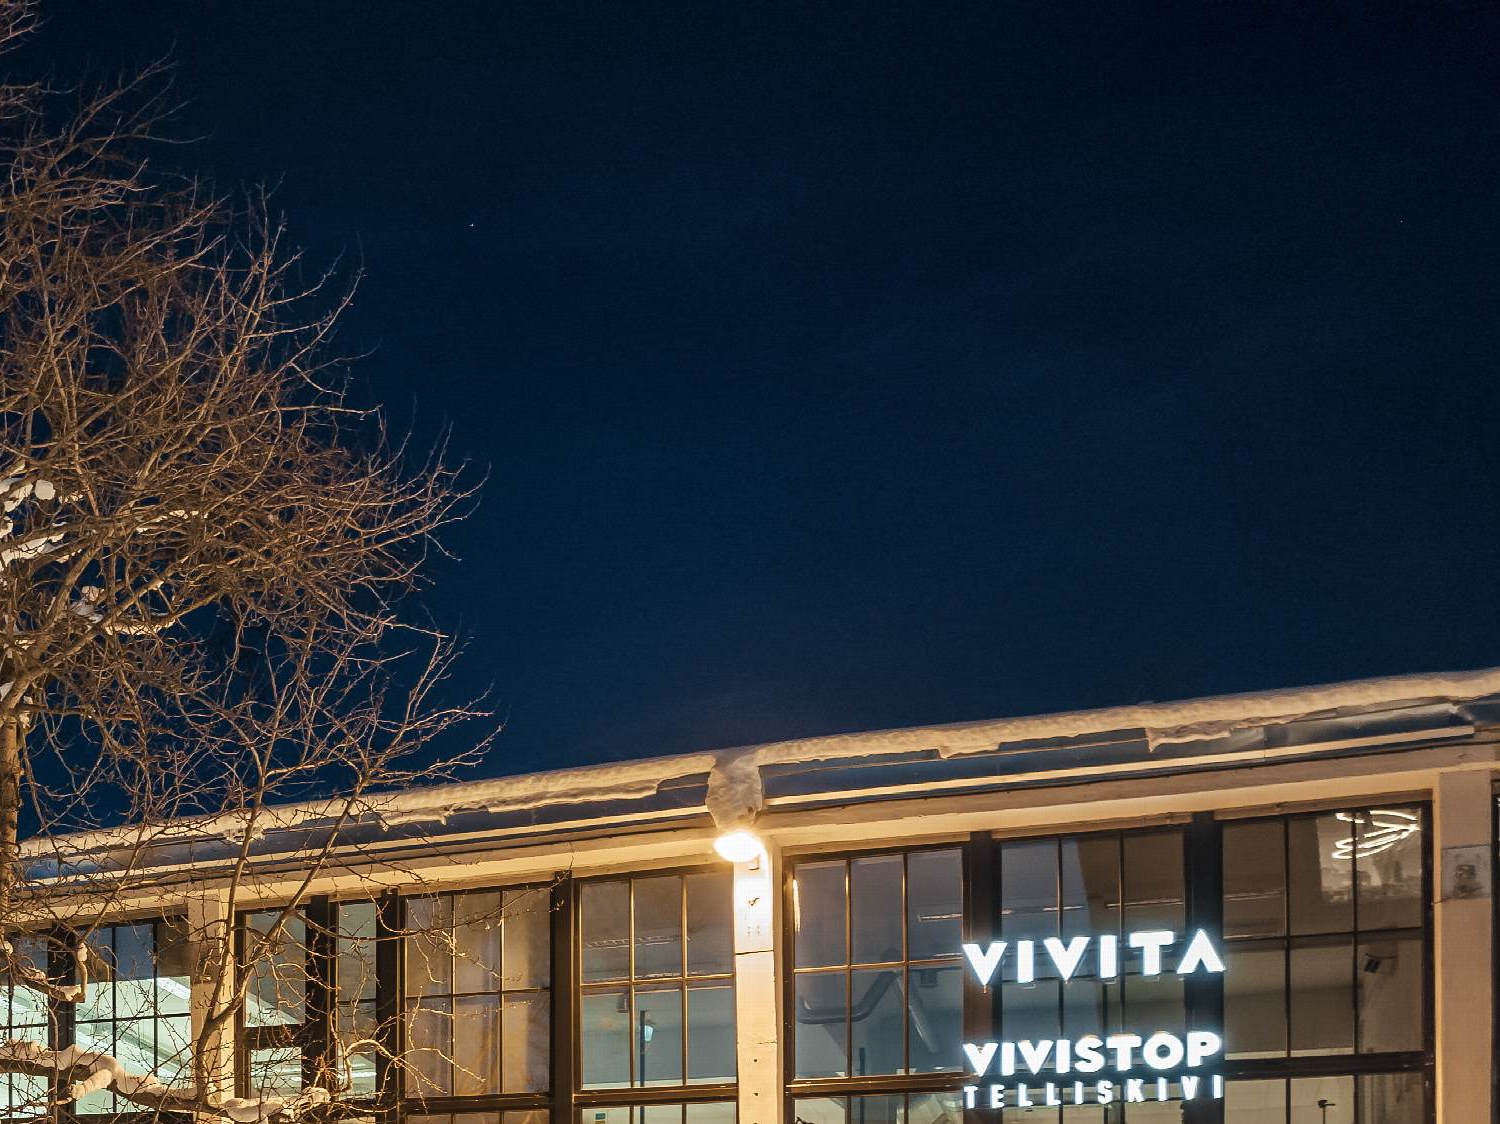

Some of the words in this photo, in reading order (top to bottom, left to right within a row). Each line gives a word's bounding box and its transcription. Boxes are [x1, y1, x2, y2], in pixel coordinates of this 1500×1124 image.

[962, 928, 1226, 986] VIVITA
[963, 1031, 1223, 1078] VIVISTOP
[963, 1074, 1225, 1109] TELLISKIVI
